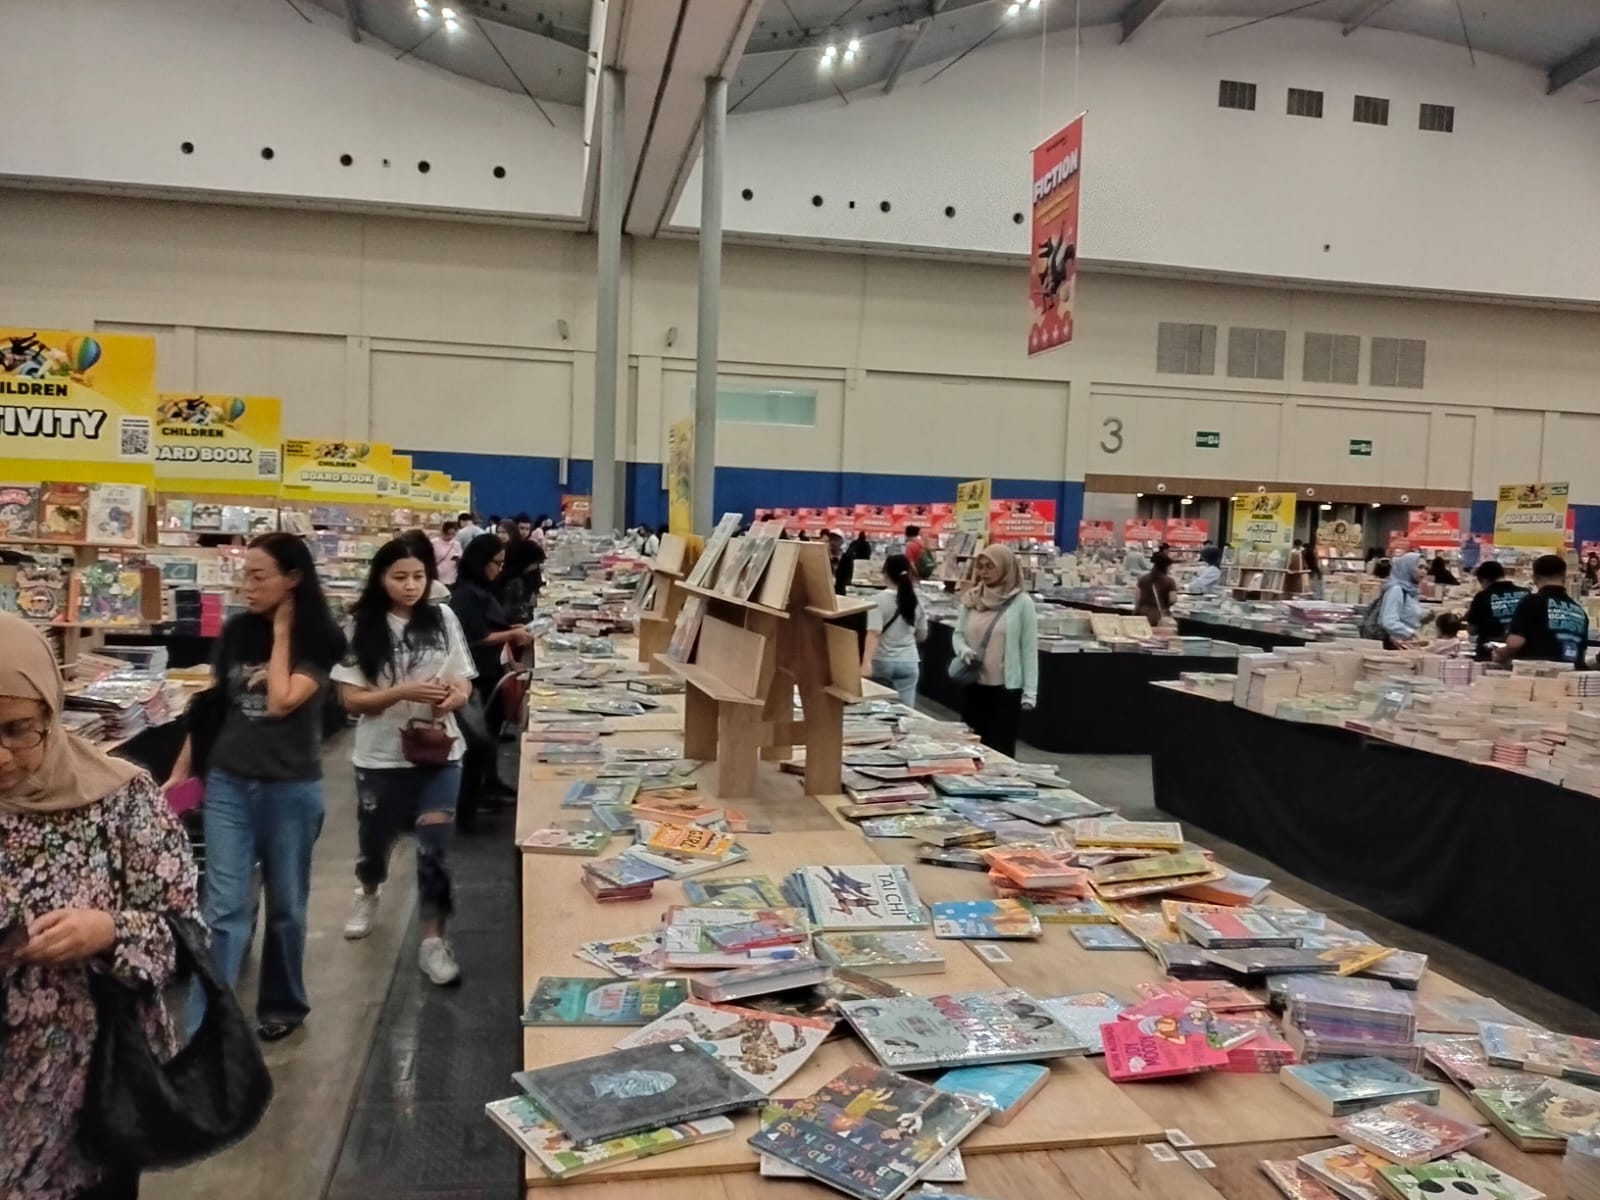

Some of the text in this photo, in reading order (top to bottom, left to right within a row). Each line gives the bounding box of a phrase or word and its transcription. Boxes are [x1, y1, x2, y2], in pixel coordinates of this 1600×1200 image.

[1032, 147, 1079, 206] FICTION
[162, 427, 224, 438] CHILDREN
[1100, 417, 1123, 454] 3
[155, 445, 252, 463] ARD BOOK
[301, 471, 375, 484] BOARD BOOK
[1531, 512, 1555, 523] BOOK
[680, 829, 704, 848] GIRL
[877, 872, 906, 915] TAI CHI
[1139, 1036, 1161, 1066] MOODY
